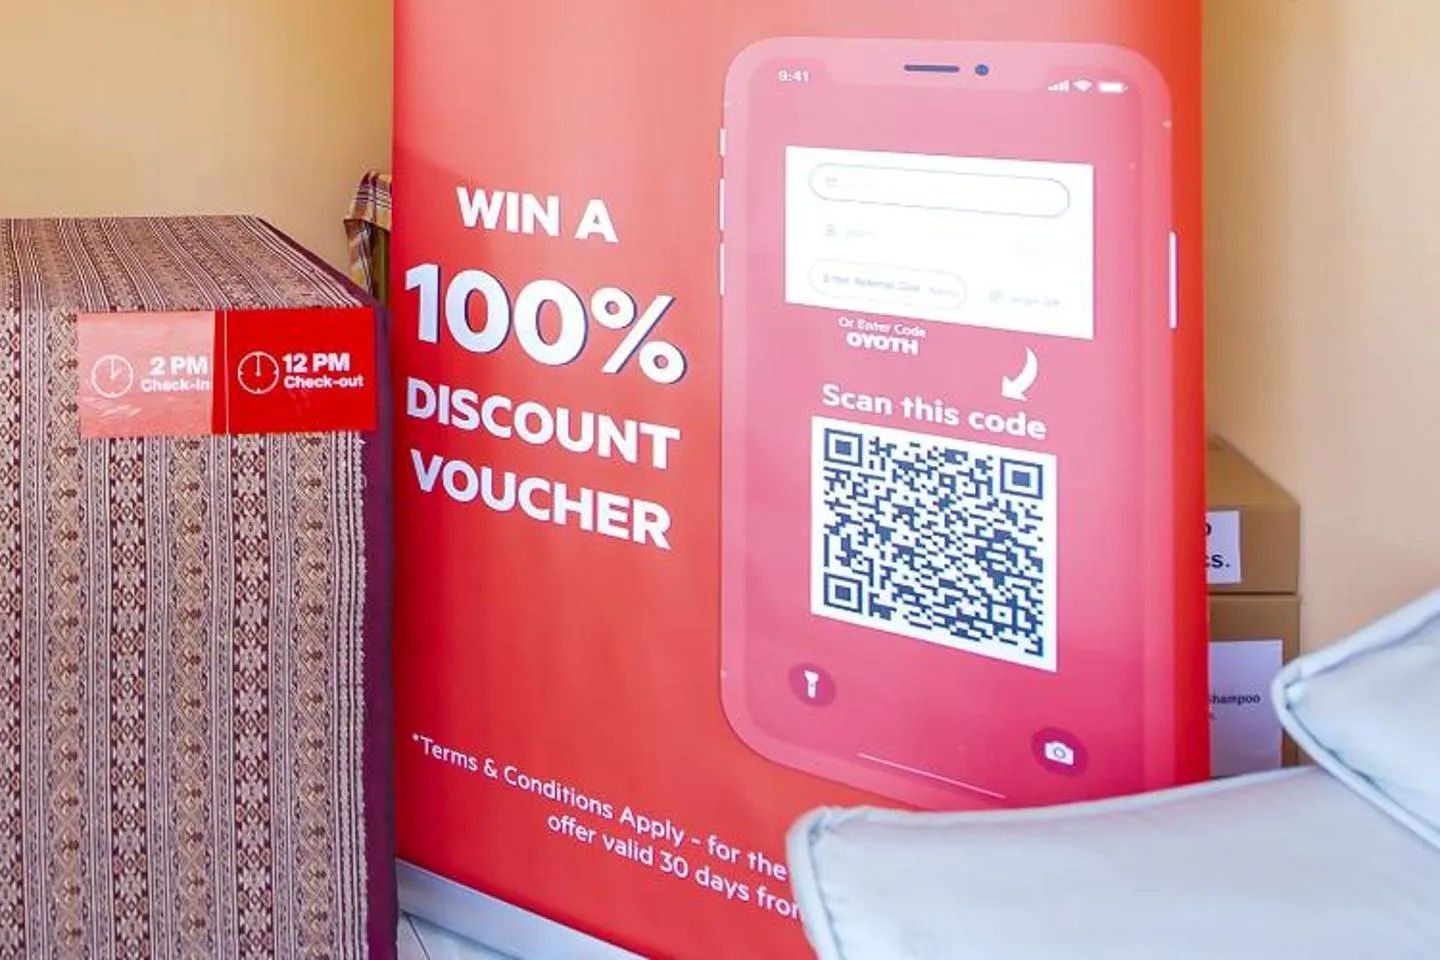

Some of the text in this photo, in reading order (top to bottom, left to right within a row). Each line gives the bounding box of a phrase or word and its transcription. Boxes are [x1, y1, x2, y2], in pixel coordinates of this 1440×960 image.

[777, 70, 809, 83] 9:41
[456, 186, 619, 243] WIN A
[405, 263, 687, 384] 100%
[838, 316, 855, 329] Or
[894, 323, 927, 339] Code
[846, 331, 919, 356] OYOTH
[150, 356, 208, 375] 2 PM
[282, 352, 350, 373] 12 PM
[141, 378, 209, 393] Check-in
[283, 374, 364, 389] Check-out
[406, 376, 681, 470] DISCOUNT
[822, 383, 1047, 440] Scan this code
[410, 448, 672, 550] VOUCHER
[1208, 693, 1261, 706] hampoo
[483, 758, 498, 779] &
[504, 765, 614, 819] Conditions
[619, 806, 684, 846] Apply
[708, 835, 741, 865] for
[748, 851, 788, 882] the
[547, 815, 804, 921] offer valid 30 days fro
